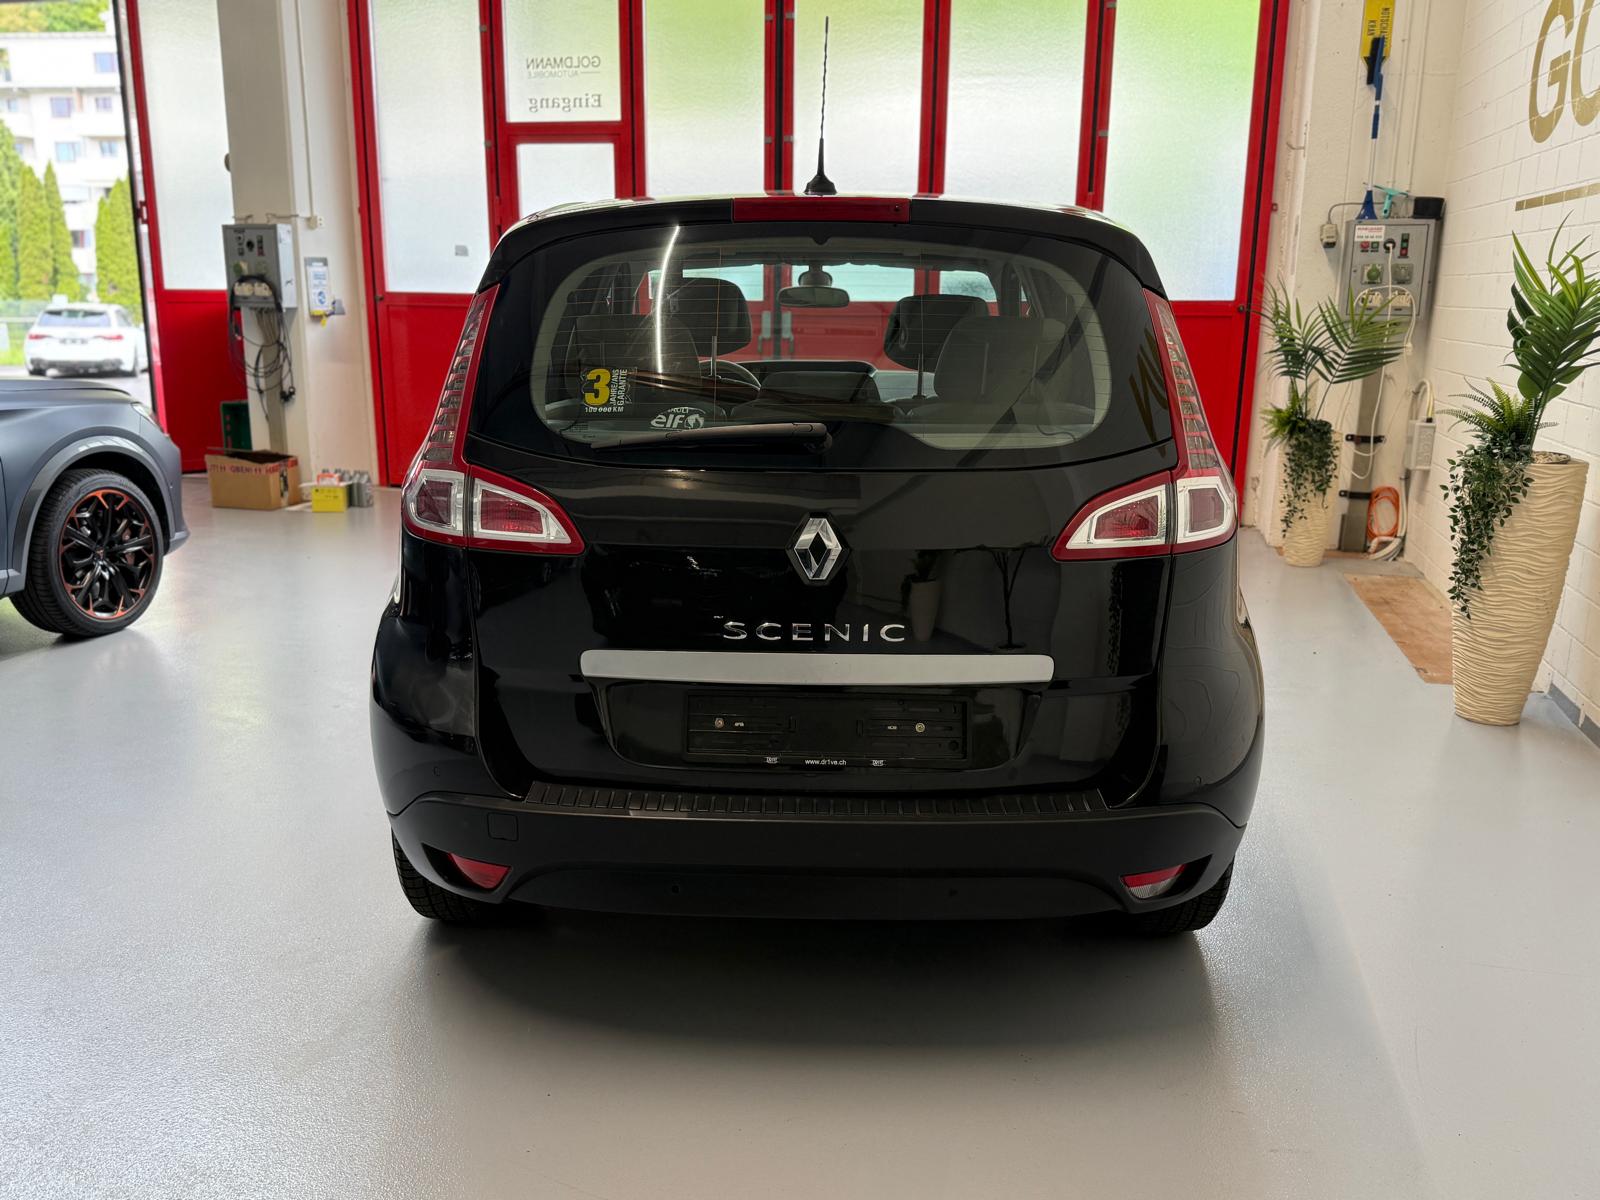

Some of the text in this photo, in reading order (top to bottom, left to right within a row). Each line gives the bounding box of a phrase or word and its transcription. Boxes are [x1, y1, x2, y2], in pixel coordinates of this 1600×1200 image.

[584, 368, 611, 406] 3
[616, 368, 627, 406] GARANTIE
[650, 413, 686, 428] elf
[723, 621, 905, 642] SCENIC
[804, 758, 847, 767] www.dr1ve.ch
